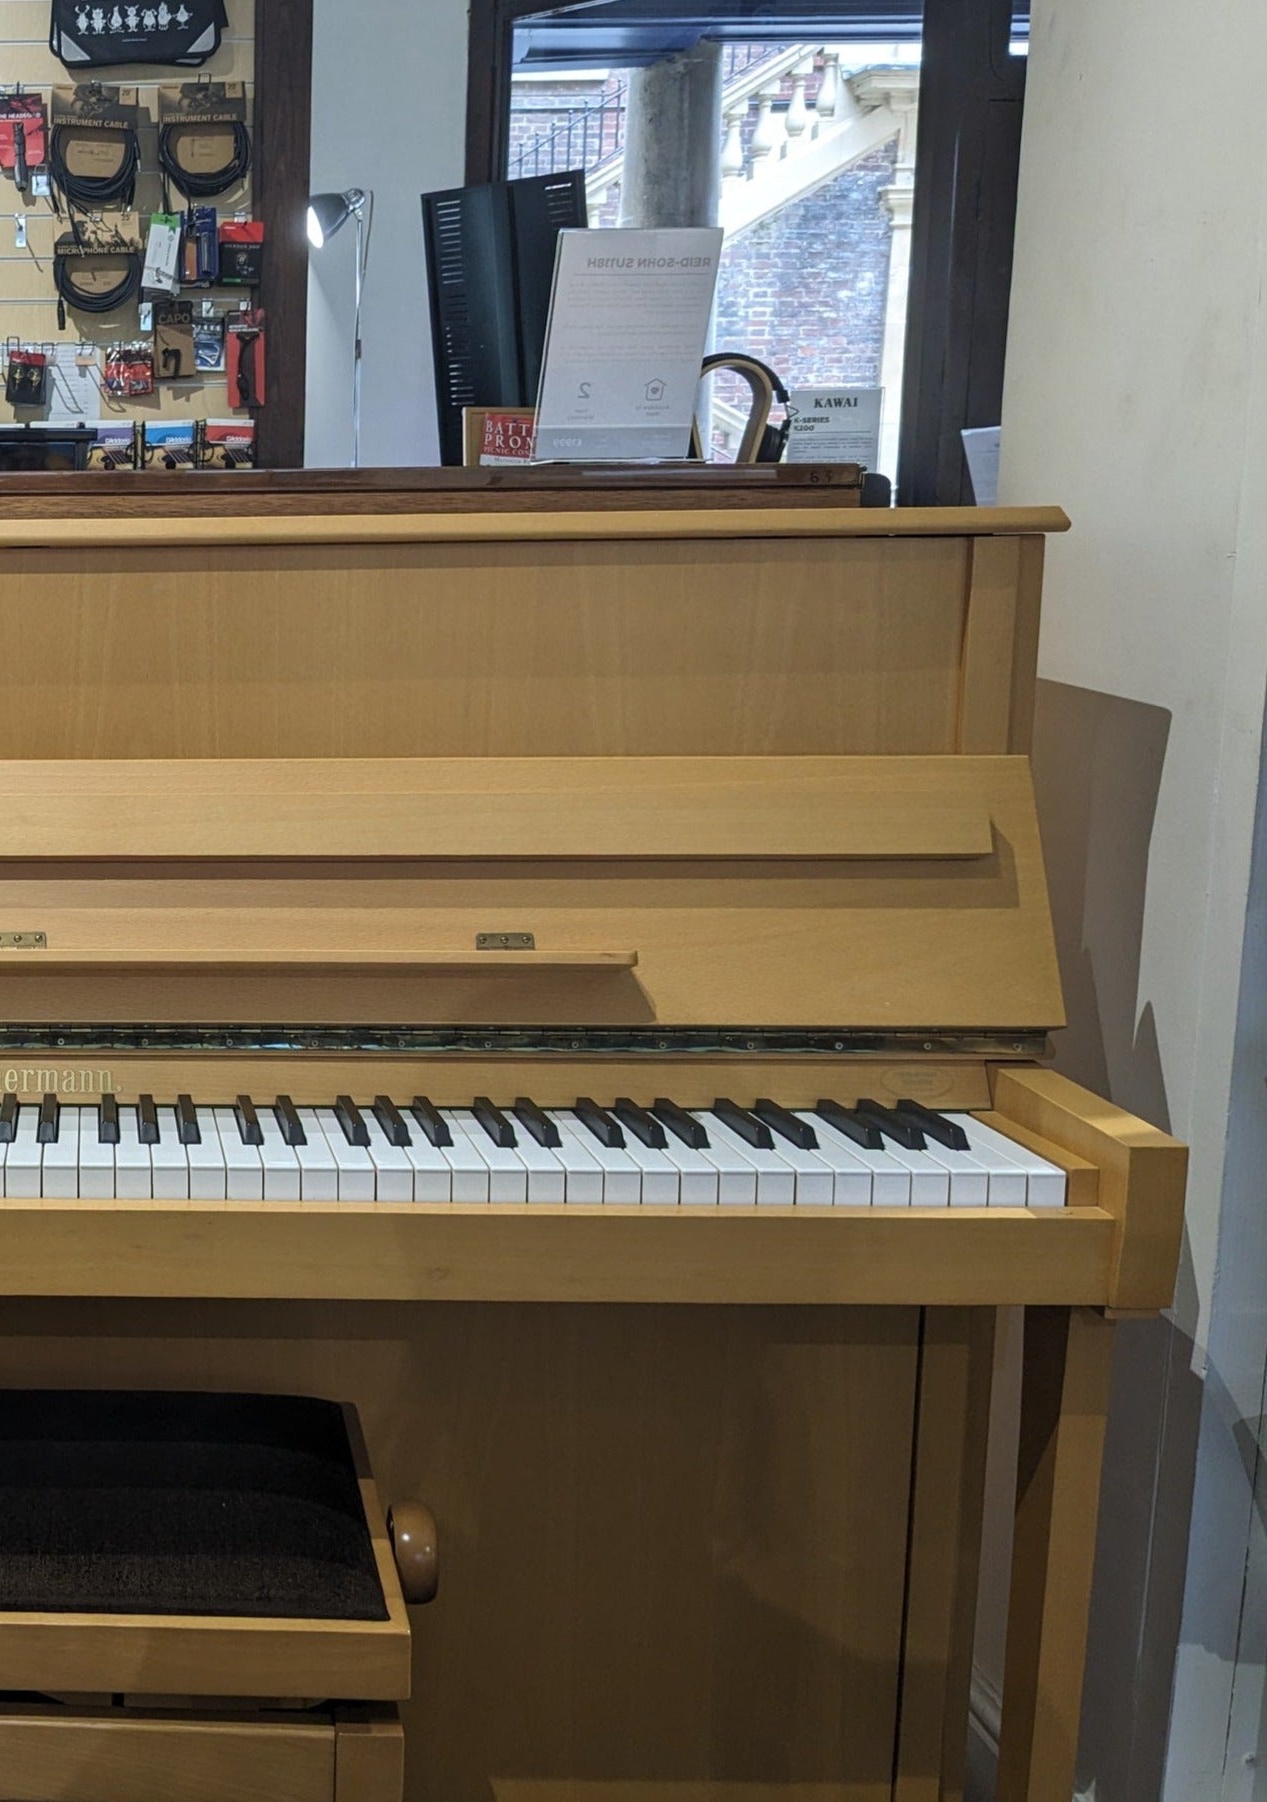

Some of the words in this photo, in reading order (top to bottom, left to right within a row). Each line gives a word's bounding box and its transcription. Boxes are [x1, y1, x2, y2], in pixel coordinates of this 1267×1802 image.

[163, 114, 211, 122] INSTRUMENT
[212, 113, 237, 121] CABLE
[53, 118, 102, 127] INSTRUMENT
[104, 120, 129, 129] CABLE
[110, 246, 134, 254] CABLE
[158, 313, 190, 324] CAPO
[814, 397, 859, 409] KAWAI
[483, 446, 510, 455] PICNIC
